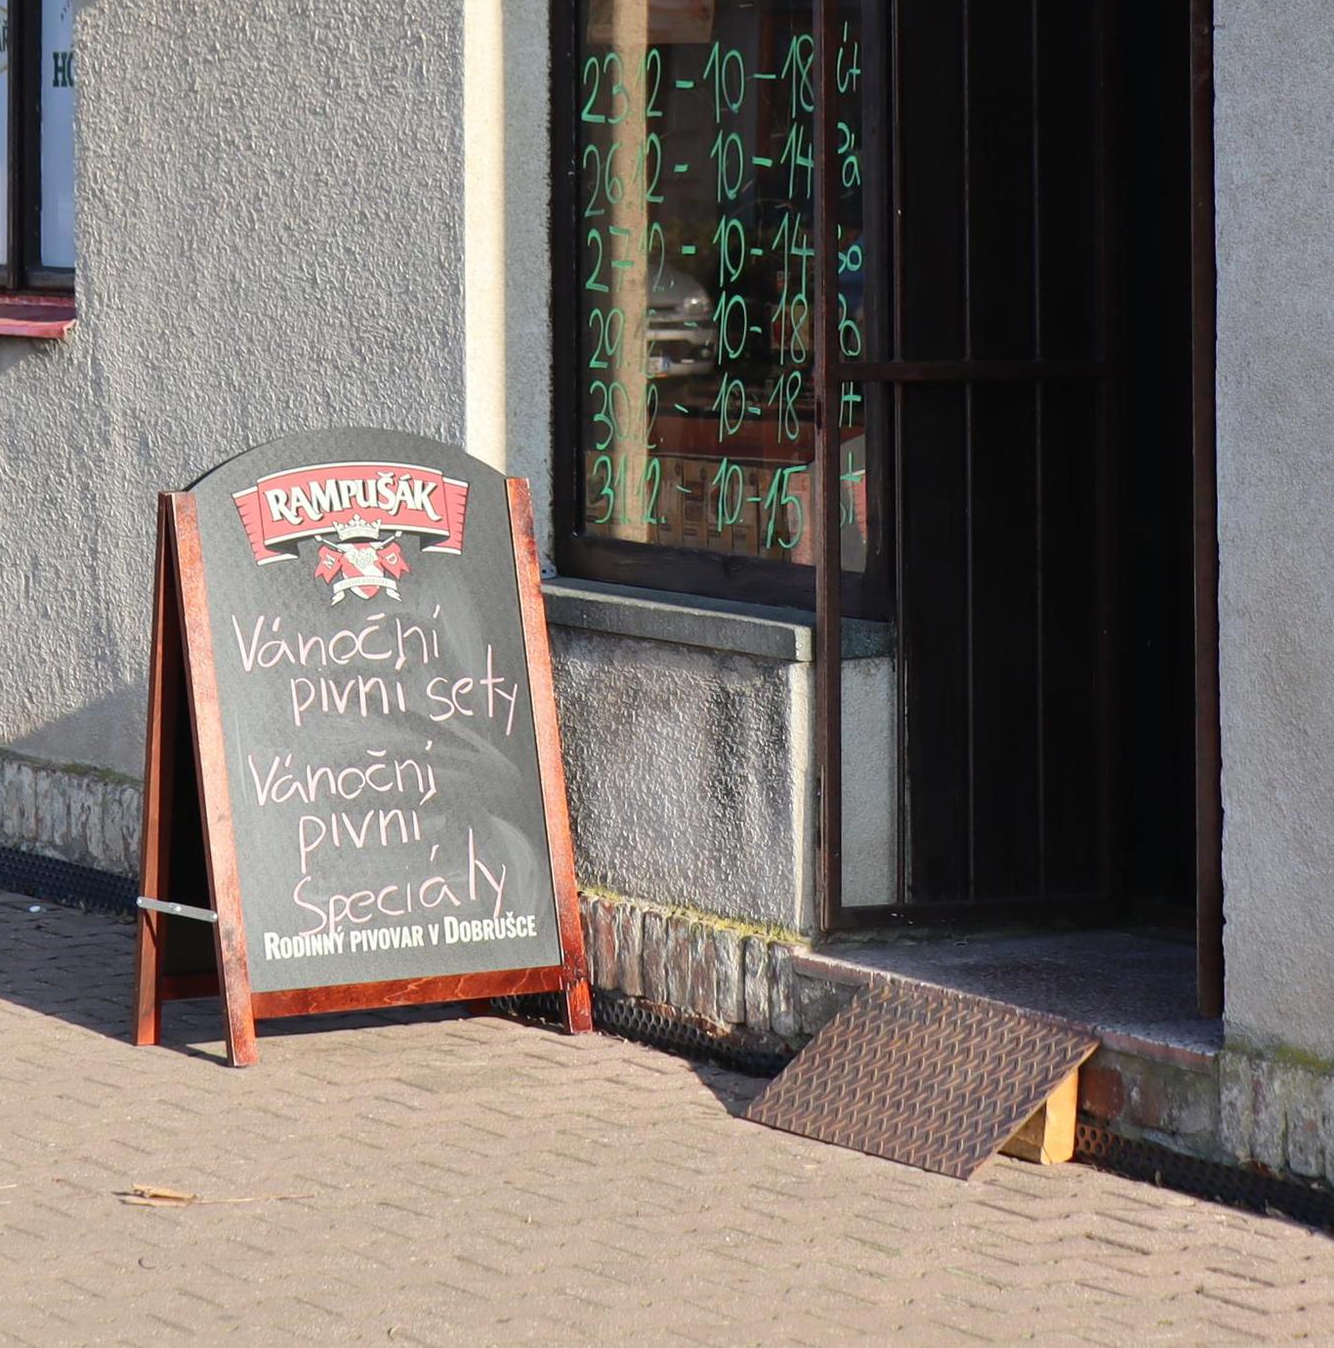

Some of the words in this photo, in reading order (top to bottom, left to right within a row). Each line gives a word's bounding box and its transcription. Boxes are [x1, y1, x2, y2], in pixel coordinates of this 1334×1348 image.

[264, 471, 443, 525] RAMPUŠÁK
[232, 604, 440, 672] Vánoční
[427, 644, 517, 736] sety
[248, 739, 436, 806] Vánoční
